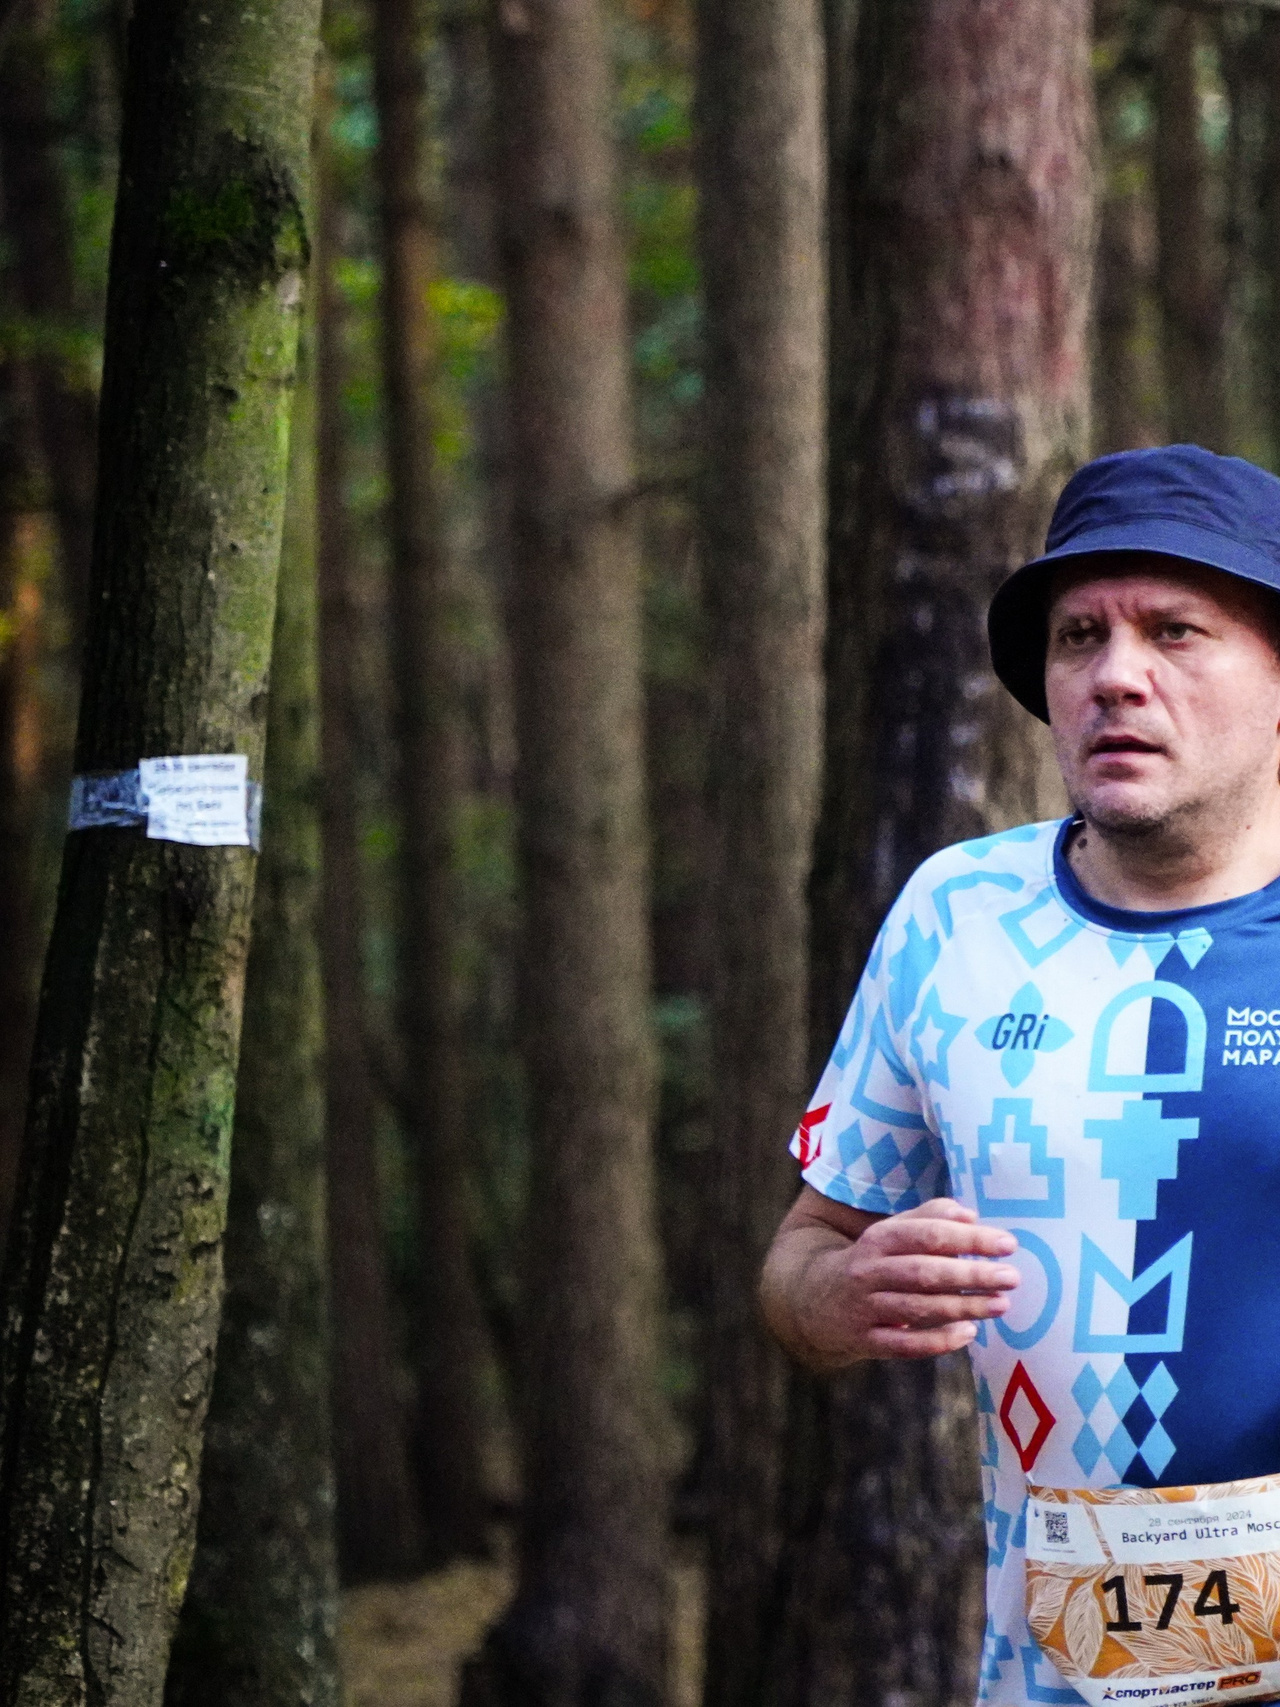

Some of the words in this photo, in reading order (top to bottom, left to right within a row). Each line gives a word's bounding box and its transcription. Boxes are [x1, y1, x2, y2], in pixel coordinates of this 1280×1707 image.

[991, 1013, 1049, 1051] GRi
[1148, 1517, 1162, 1527] 28
[1167, 1514, 1220, 1527] сентября
[1226, 1510, 1252, 1521] 2024
[1122, 1529, 1187, 1544] Backyard
[1195, 1525, 1238, 1539] Ultra
[1102, 1570, 1240, 1632] 174
[1219, 1672, 1260, 1690] PRO
